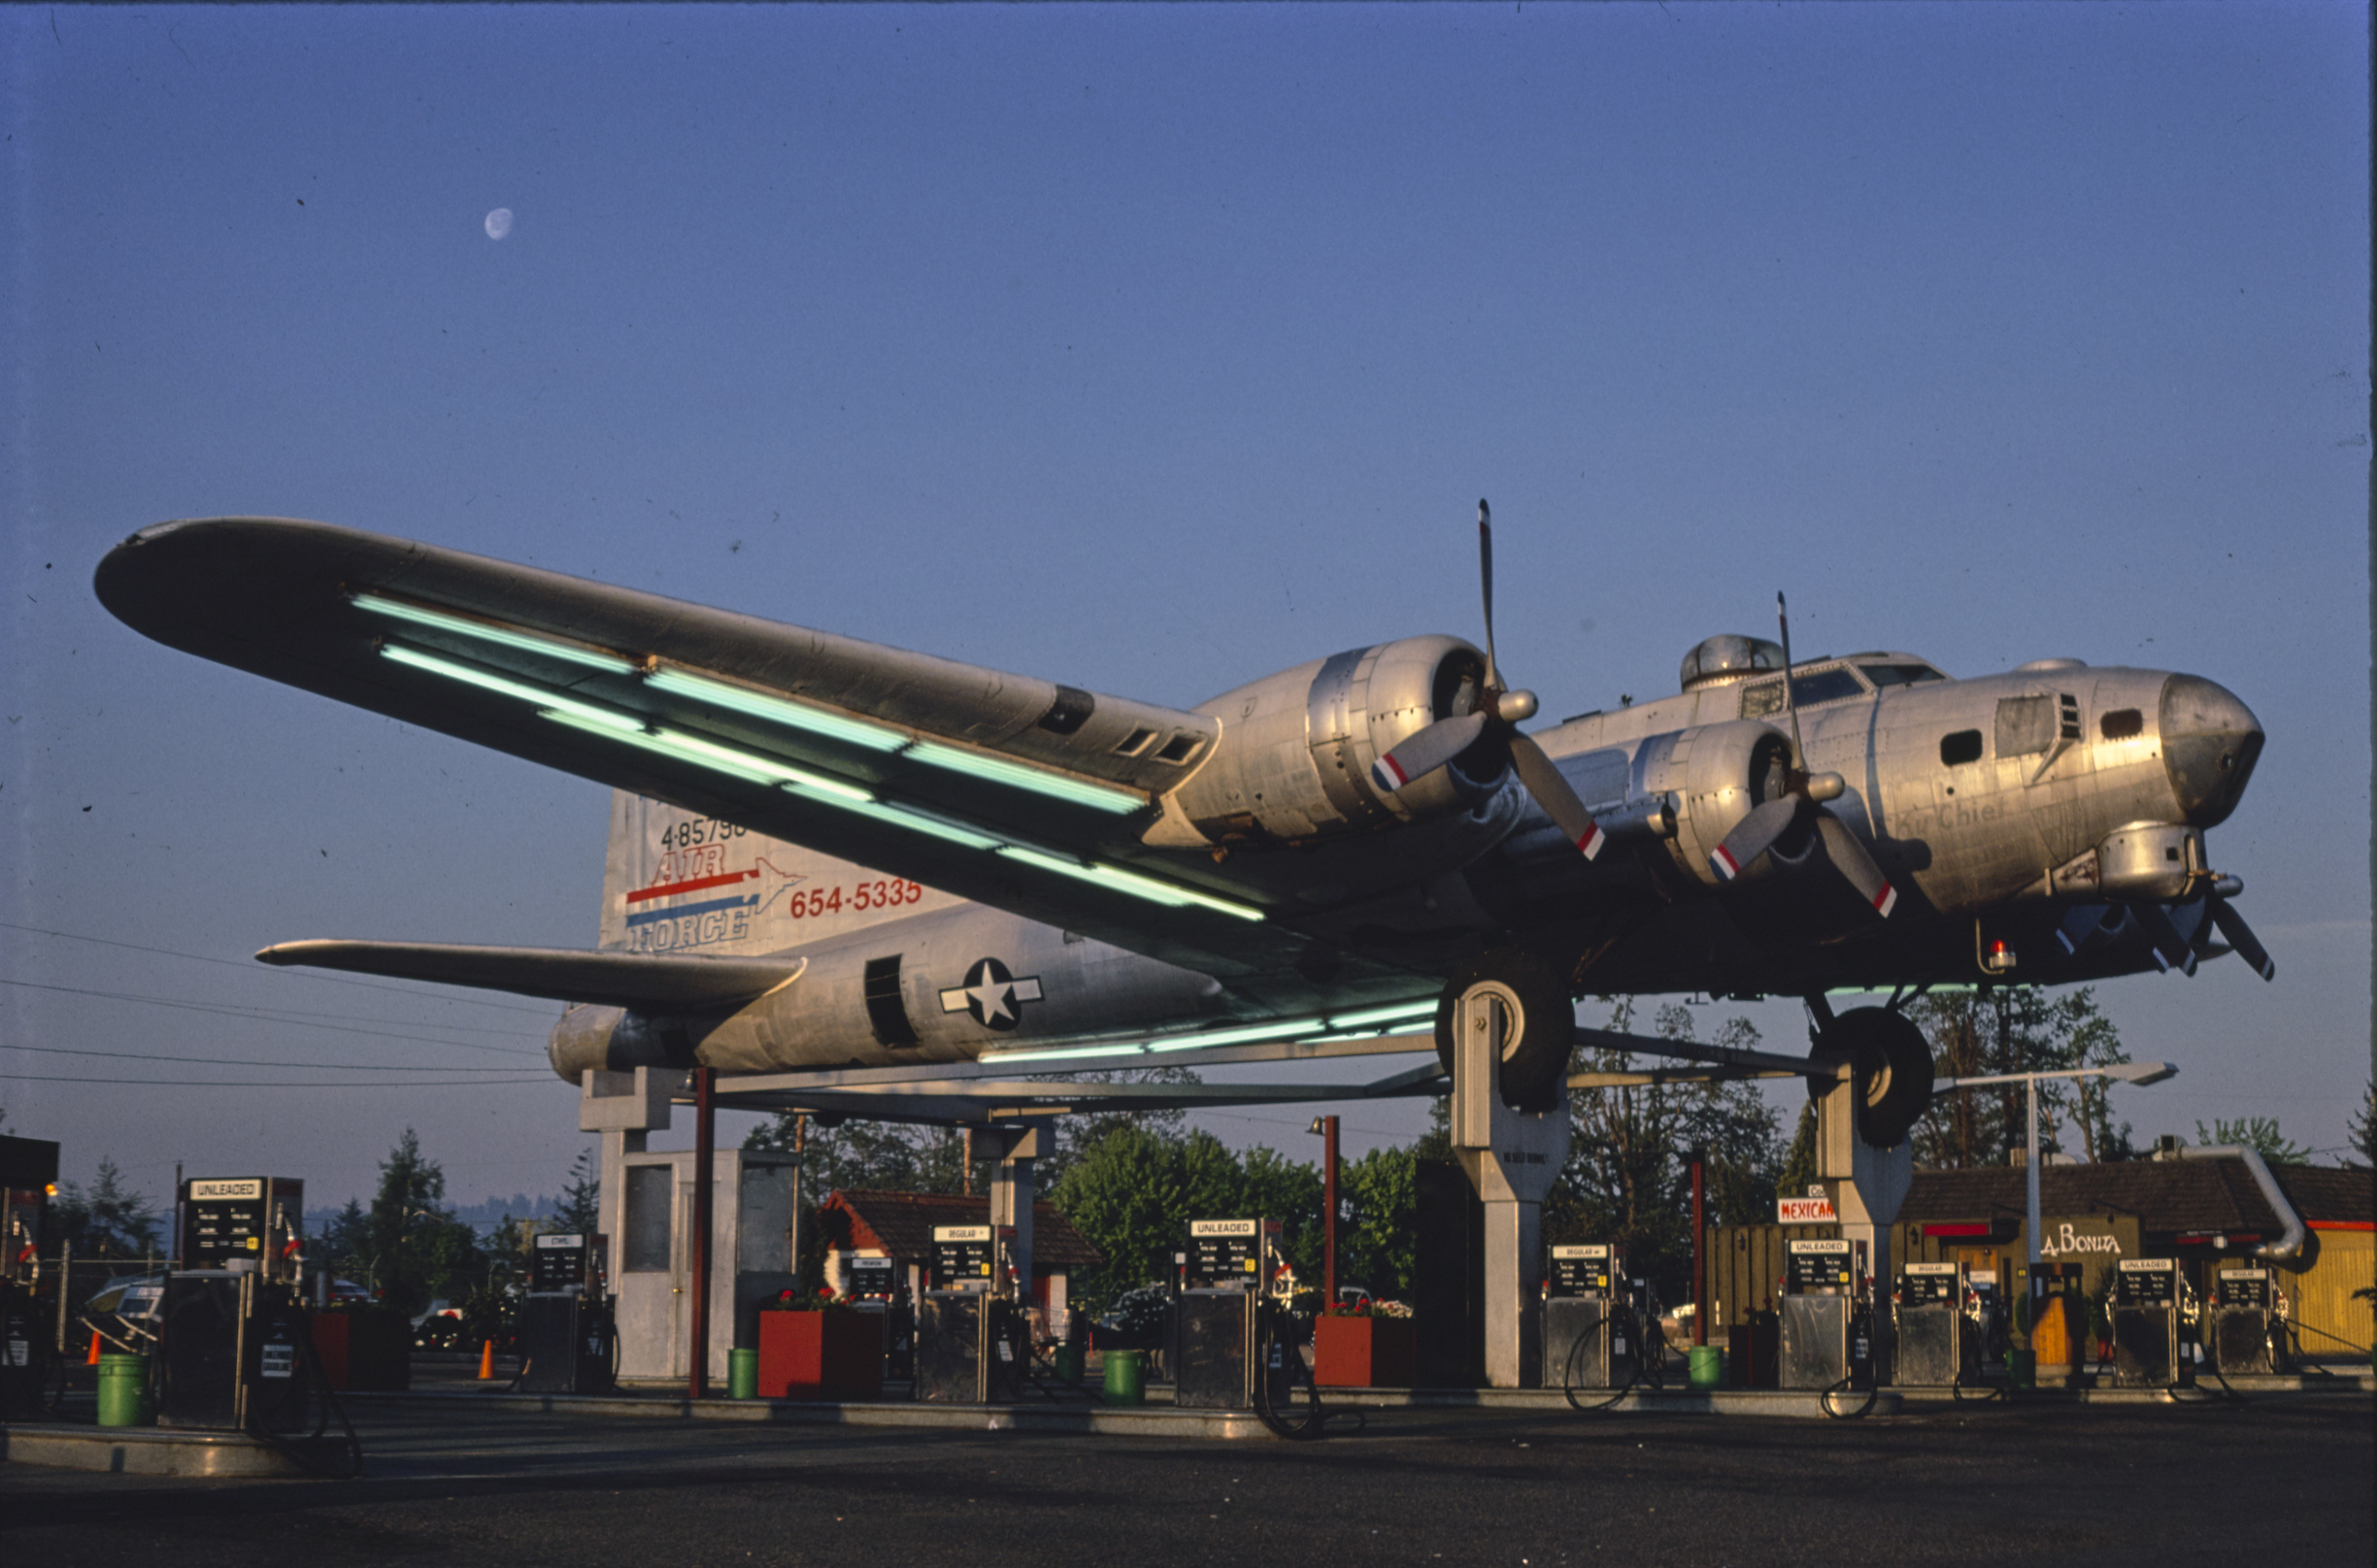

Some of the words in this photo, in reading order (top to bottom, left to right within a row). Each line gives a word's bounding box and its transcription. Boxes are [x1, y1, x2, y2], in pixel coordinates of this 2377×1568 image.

[651, 844, 725, 891] AIR
[789, 877, 922, 919] 654-5335
[627, 904, 751, 952] FORCE
[197, 1184, 254, 1196] UNLEADED
[1810, 1186, 1826, 1197] Co
[1197, 1222, 1250, 1233] UNLEADED
[948, 1229, 977, 1238] REGULAR
[1796, 1242, 1843, 1251] UNLEADED
